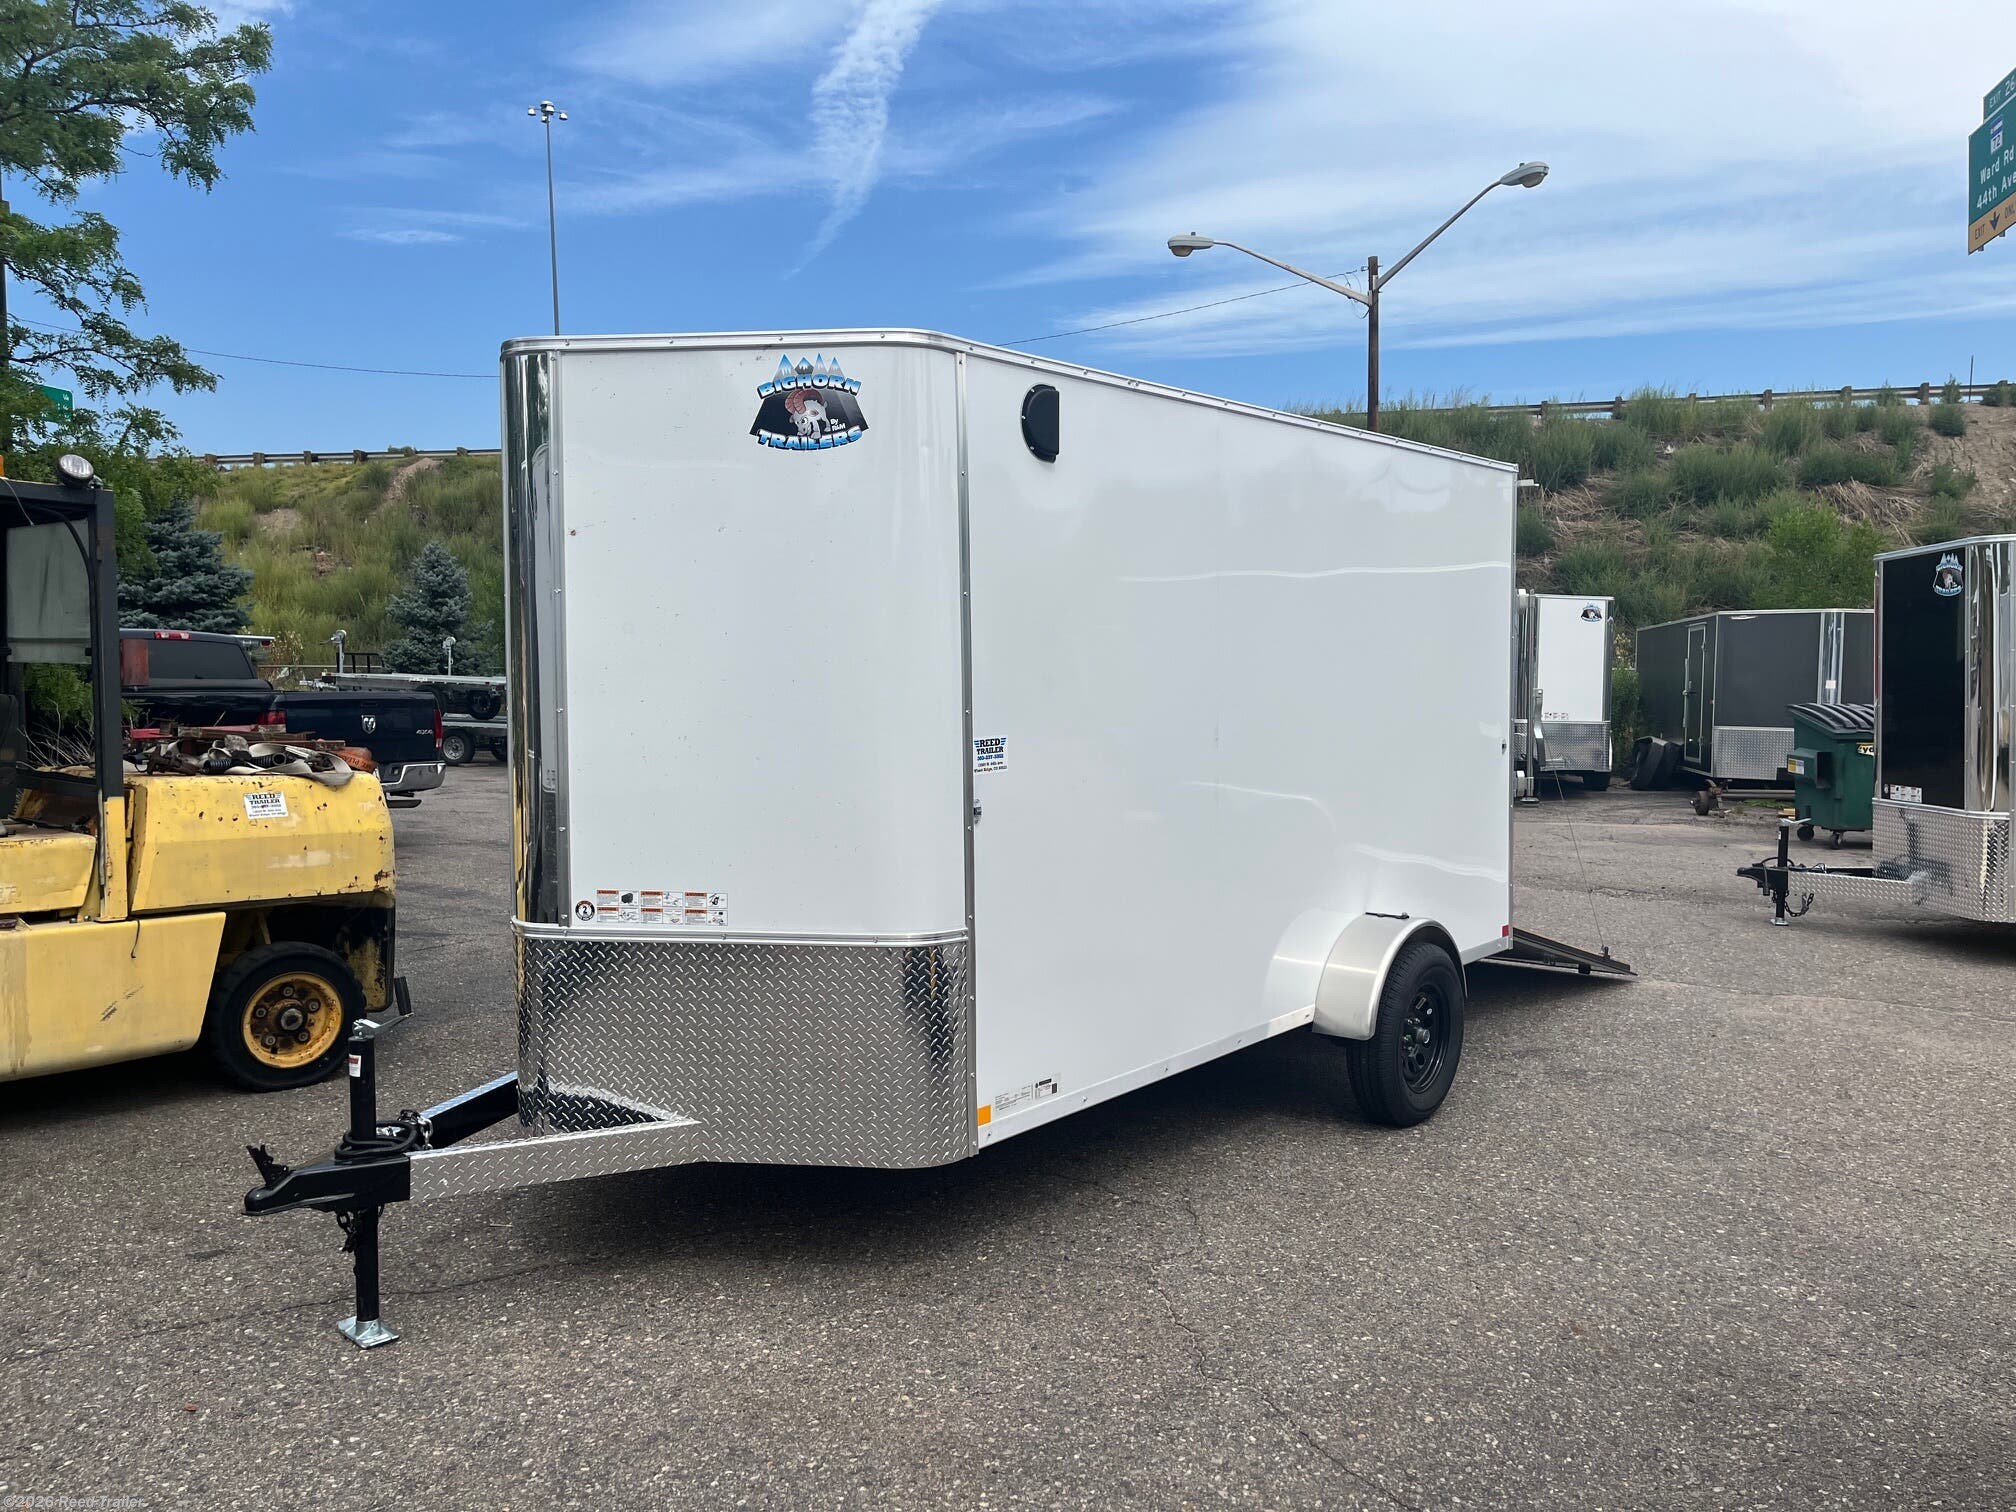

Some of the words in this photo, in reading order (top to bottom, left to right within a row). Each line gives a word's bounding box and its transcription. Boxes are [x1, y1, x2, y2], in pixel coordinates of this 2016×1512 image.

[1989, 90, 2001, 108] EXIT
[1979, 157, 2000, 185] Ward
[2003, 144, 2014, 166] Rd
[1976, 185, 1998, 210] 44th
[1974, 224, 1985, 240] EXIT
[757, 373, 862, 399] BIGHORN
[830, 418, 839, 427] By
[756, 425, 863, 451] TRAILERS
[976, 746, 1004, 755] TRAILER
[979, 738, 1001, 747] REED
